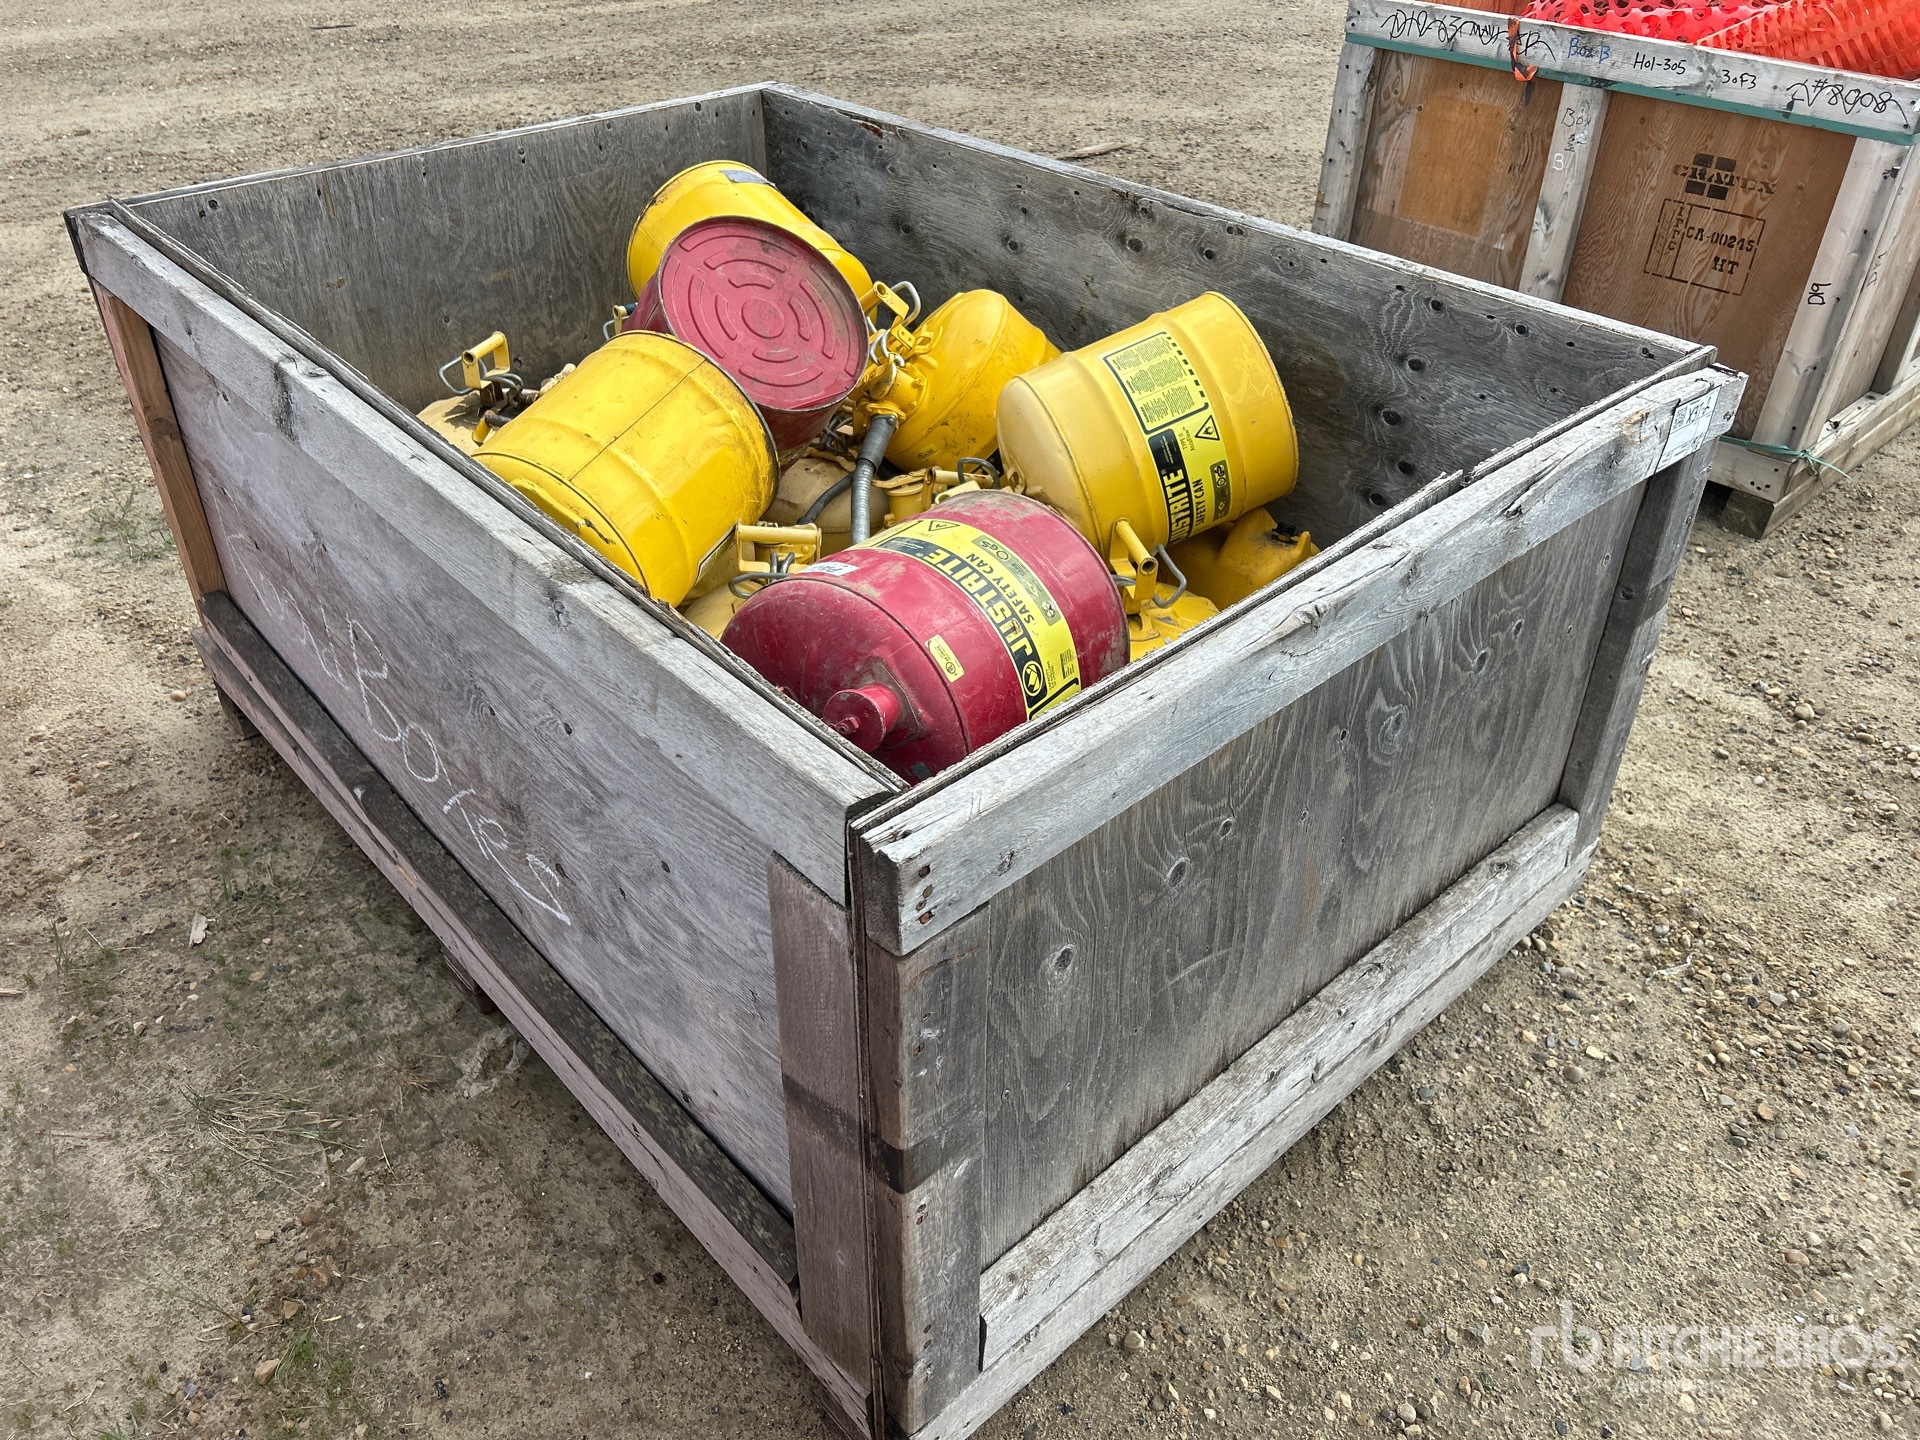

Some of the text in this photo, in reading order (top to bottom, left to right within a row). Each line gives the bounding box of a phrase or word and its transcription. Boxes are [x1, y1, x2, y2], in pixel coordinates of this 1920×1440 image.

[1561, 107, 1592, 127] Box
[1712, 256, 1740, 275] HT
[1807, 282, 1832, 306] D19
[1162, 468, 1191, 542] JUSTRITE
[1192, 478, 1207, 527] SAFETY CAN
[922, 548, 1033, 656] JUSTRITE
[966, 553, 1035, 624] SAFETY CAN
